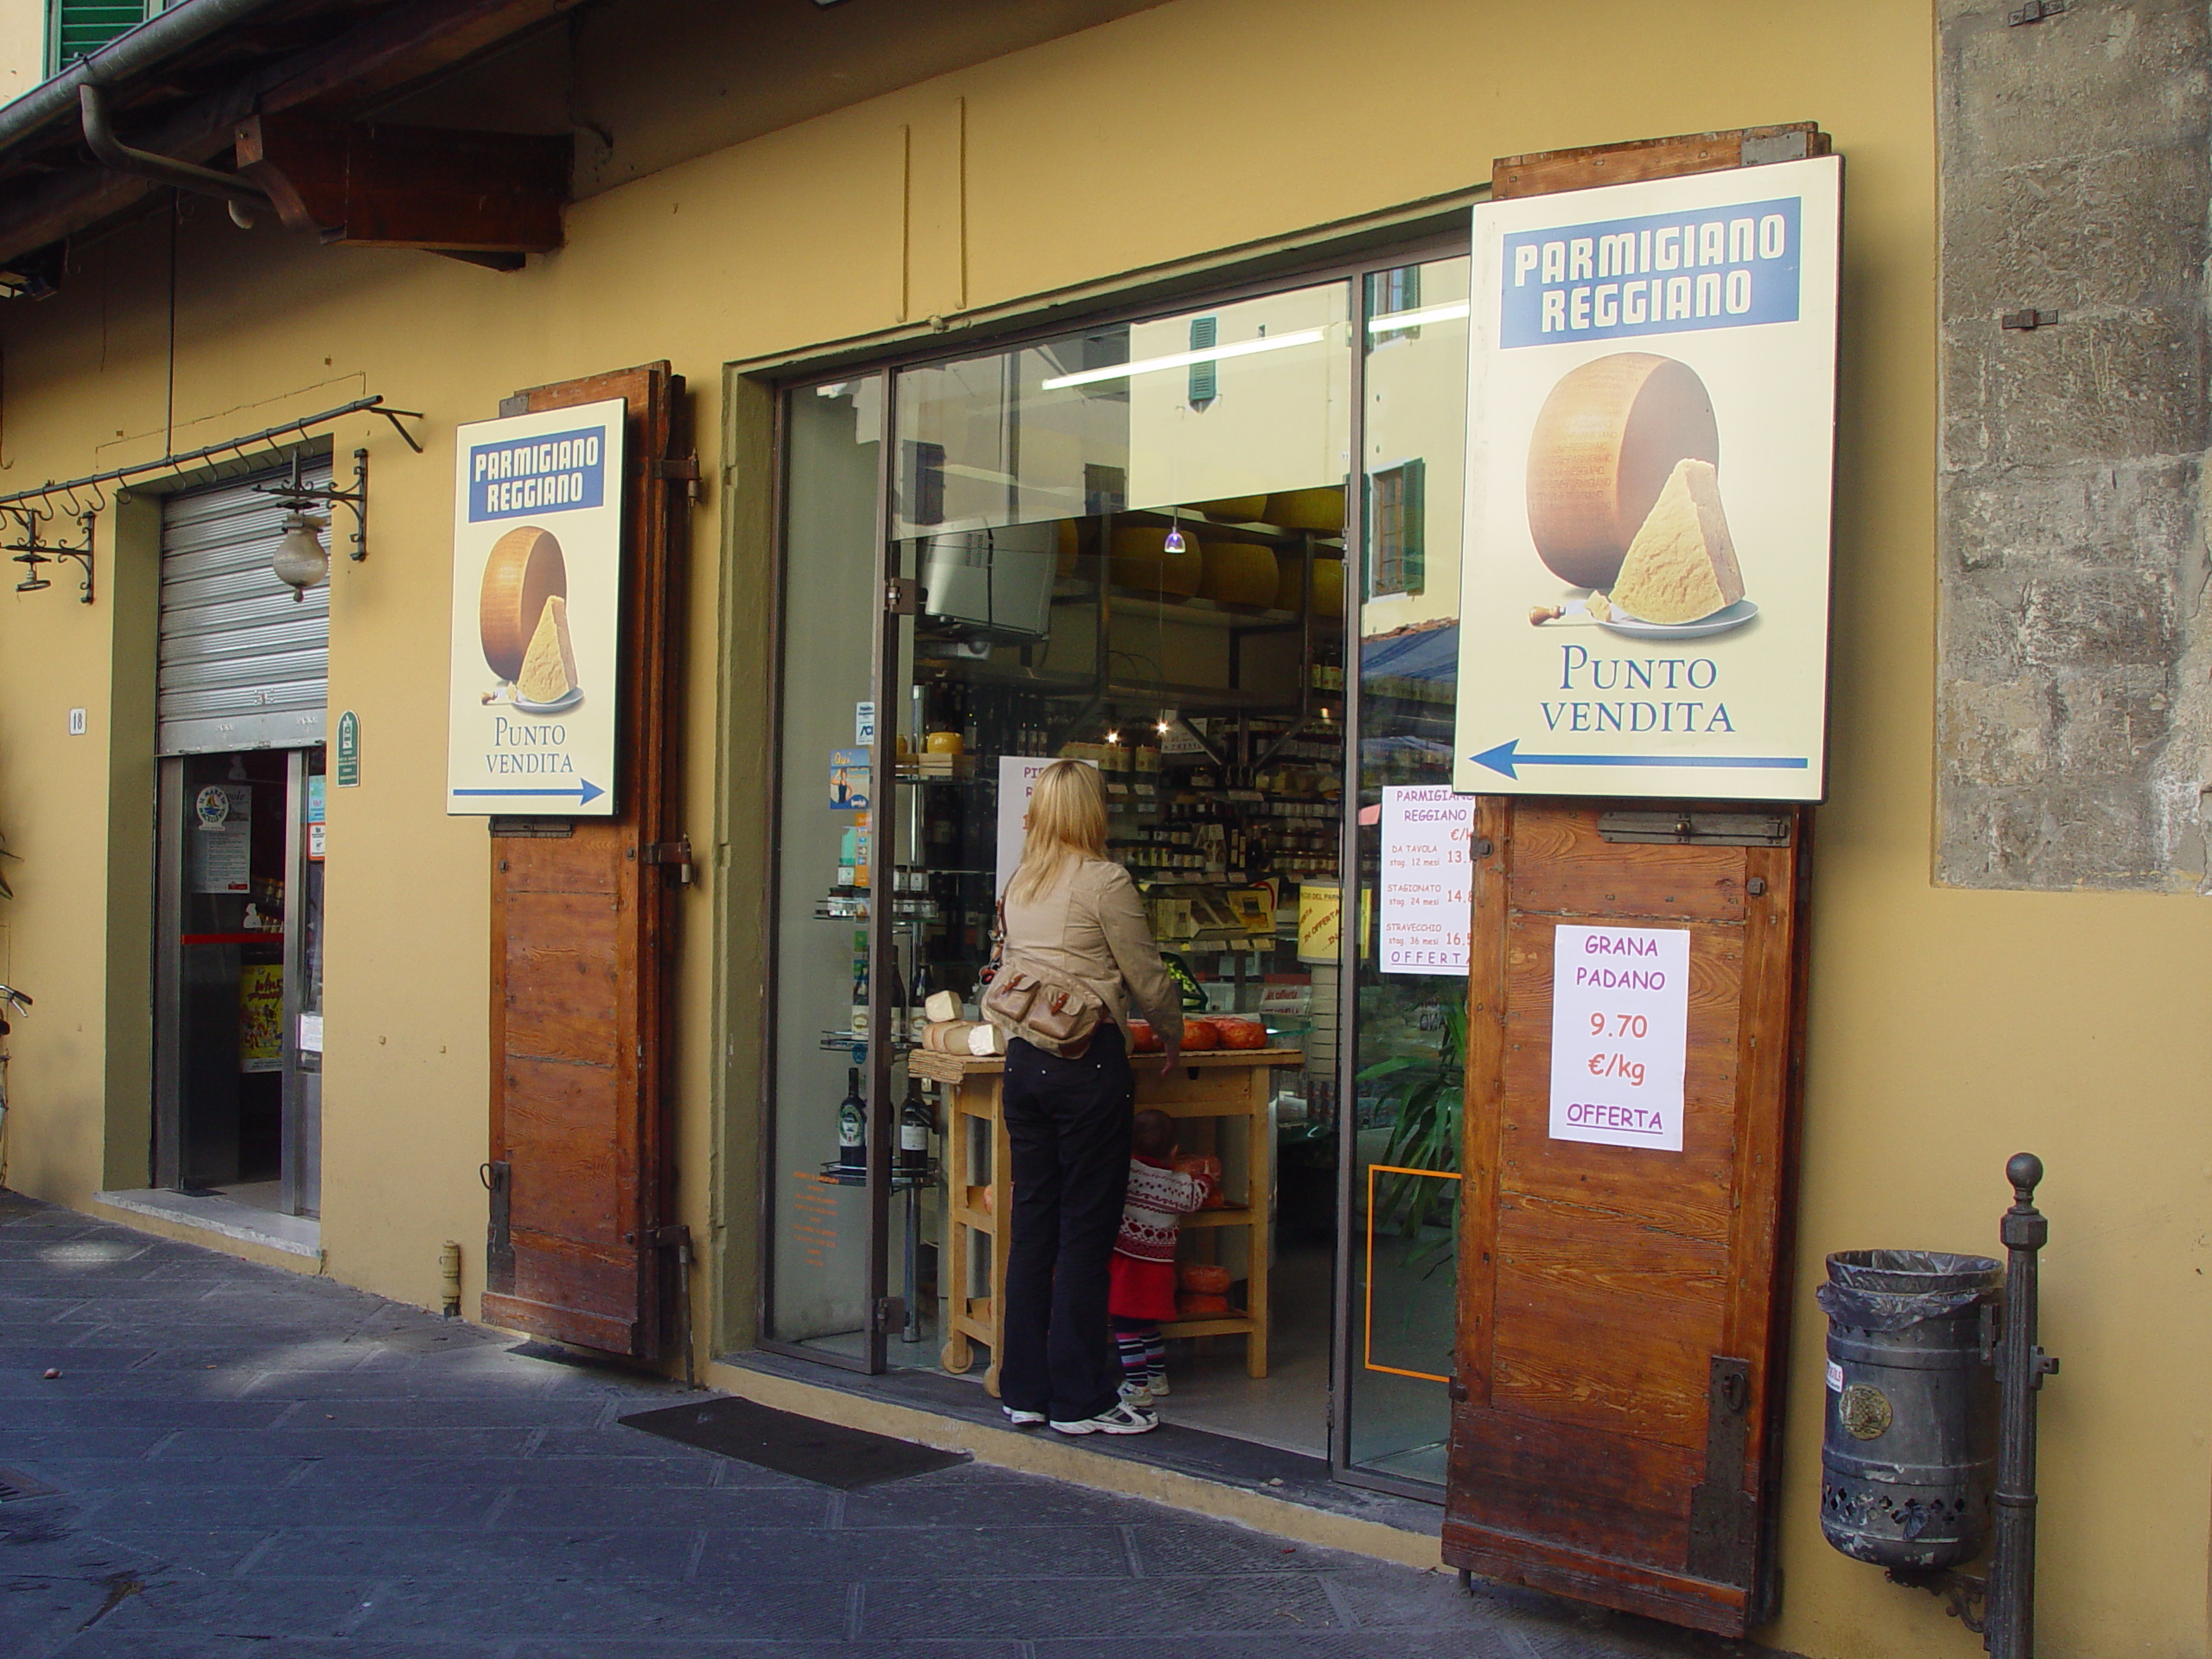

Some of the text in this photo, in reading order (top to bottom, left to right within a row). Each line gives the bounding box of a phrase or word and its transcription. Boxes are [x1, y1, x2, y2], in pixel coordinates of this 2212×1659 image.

[1514, 214, 1786, 287] PARMIGIANO
[1541, 270, 1751, 333] REGGIANO
[475, 436, 598, 482] PARMIGIANO
[487, 472, 583, 512] REGGIANO
[73, 712, 83, 730] 18
[1541, 702, 1736, 732] VENDITA
[486, 753, 574, 773] VENDITA
[1404, 810, 1467, 822] REGGIANO
[1451, 828, 1472, 841] €/k
[1387, 884, 1441, 893] STAGIONATO
[1411, 897, 1420, 906] 24
[1386, 923, 1442, 932] STRAVECCHIO
[1410, 936, 1420, 944] 36
[1585, 935, 1658, 957] GRANA
[1576, 967, 1665, 990] PADANO
[1590, 1012, 1648, 1039] 9.70
[1587, 1053, 1645, 1086] €/kg
[1567, 1103, 1663, 1130] OFFERTA
